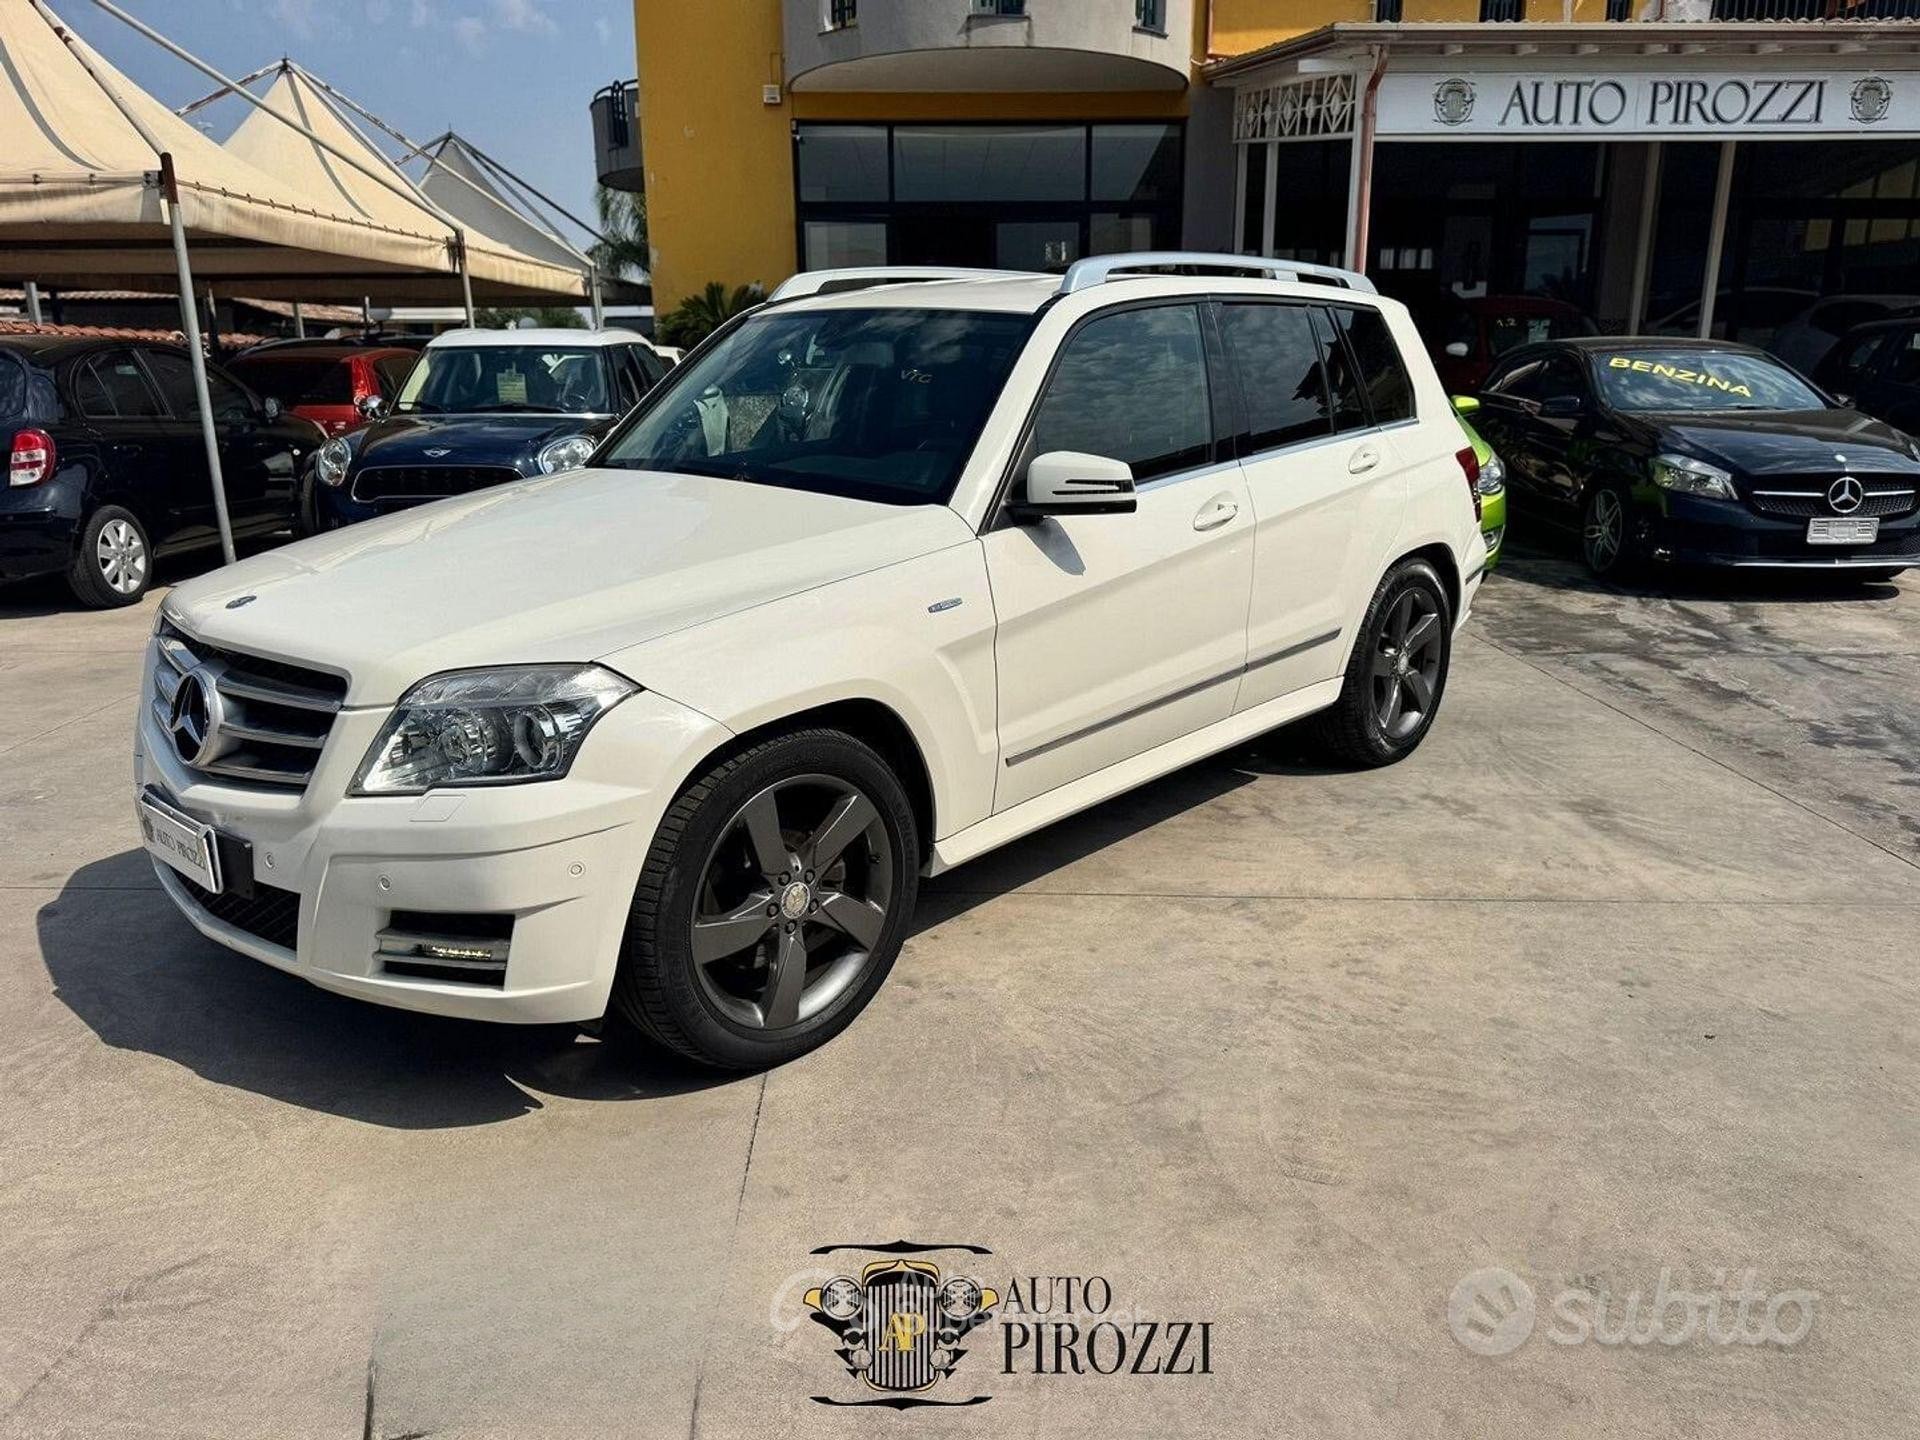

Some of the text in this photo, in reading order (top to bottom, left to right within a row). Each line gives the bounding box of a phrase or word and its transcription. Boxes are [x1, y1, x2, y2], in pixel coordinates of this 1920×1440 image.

[1498, 80, 1828, 125] AUTO PIROZZI
[1608, 356, 1752, 398] BENZINA
